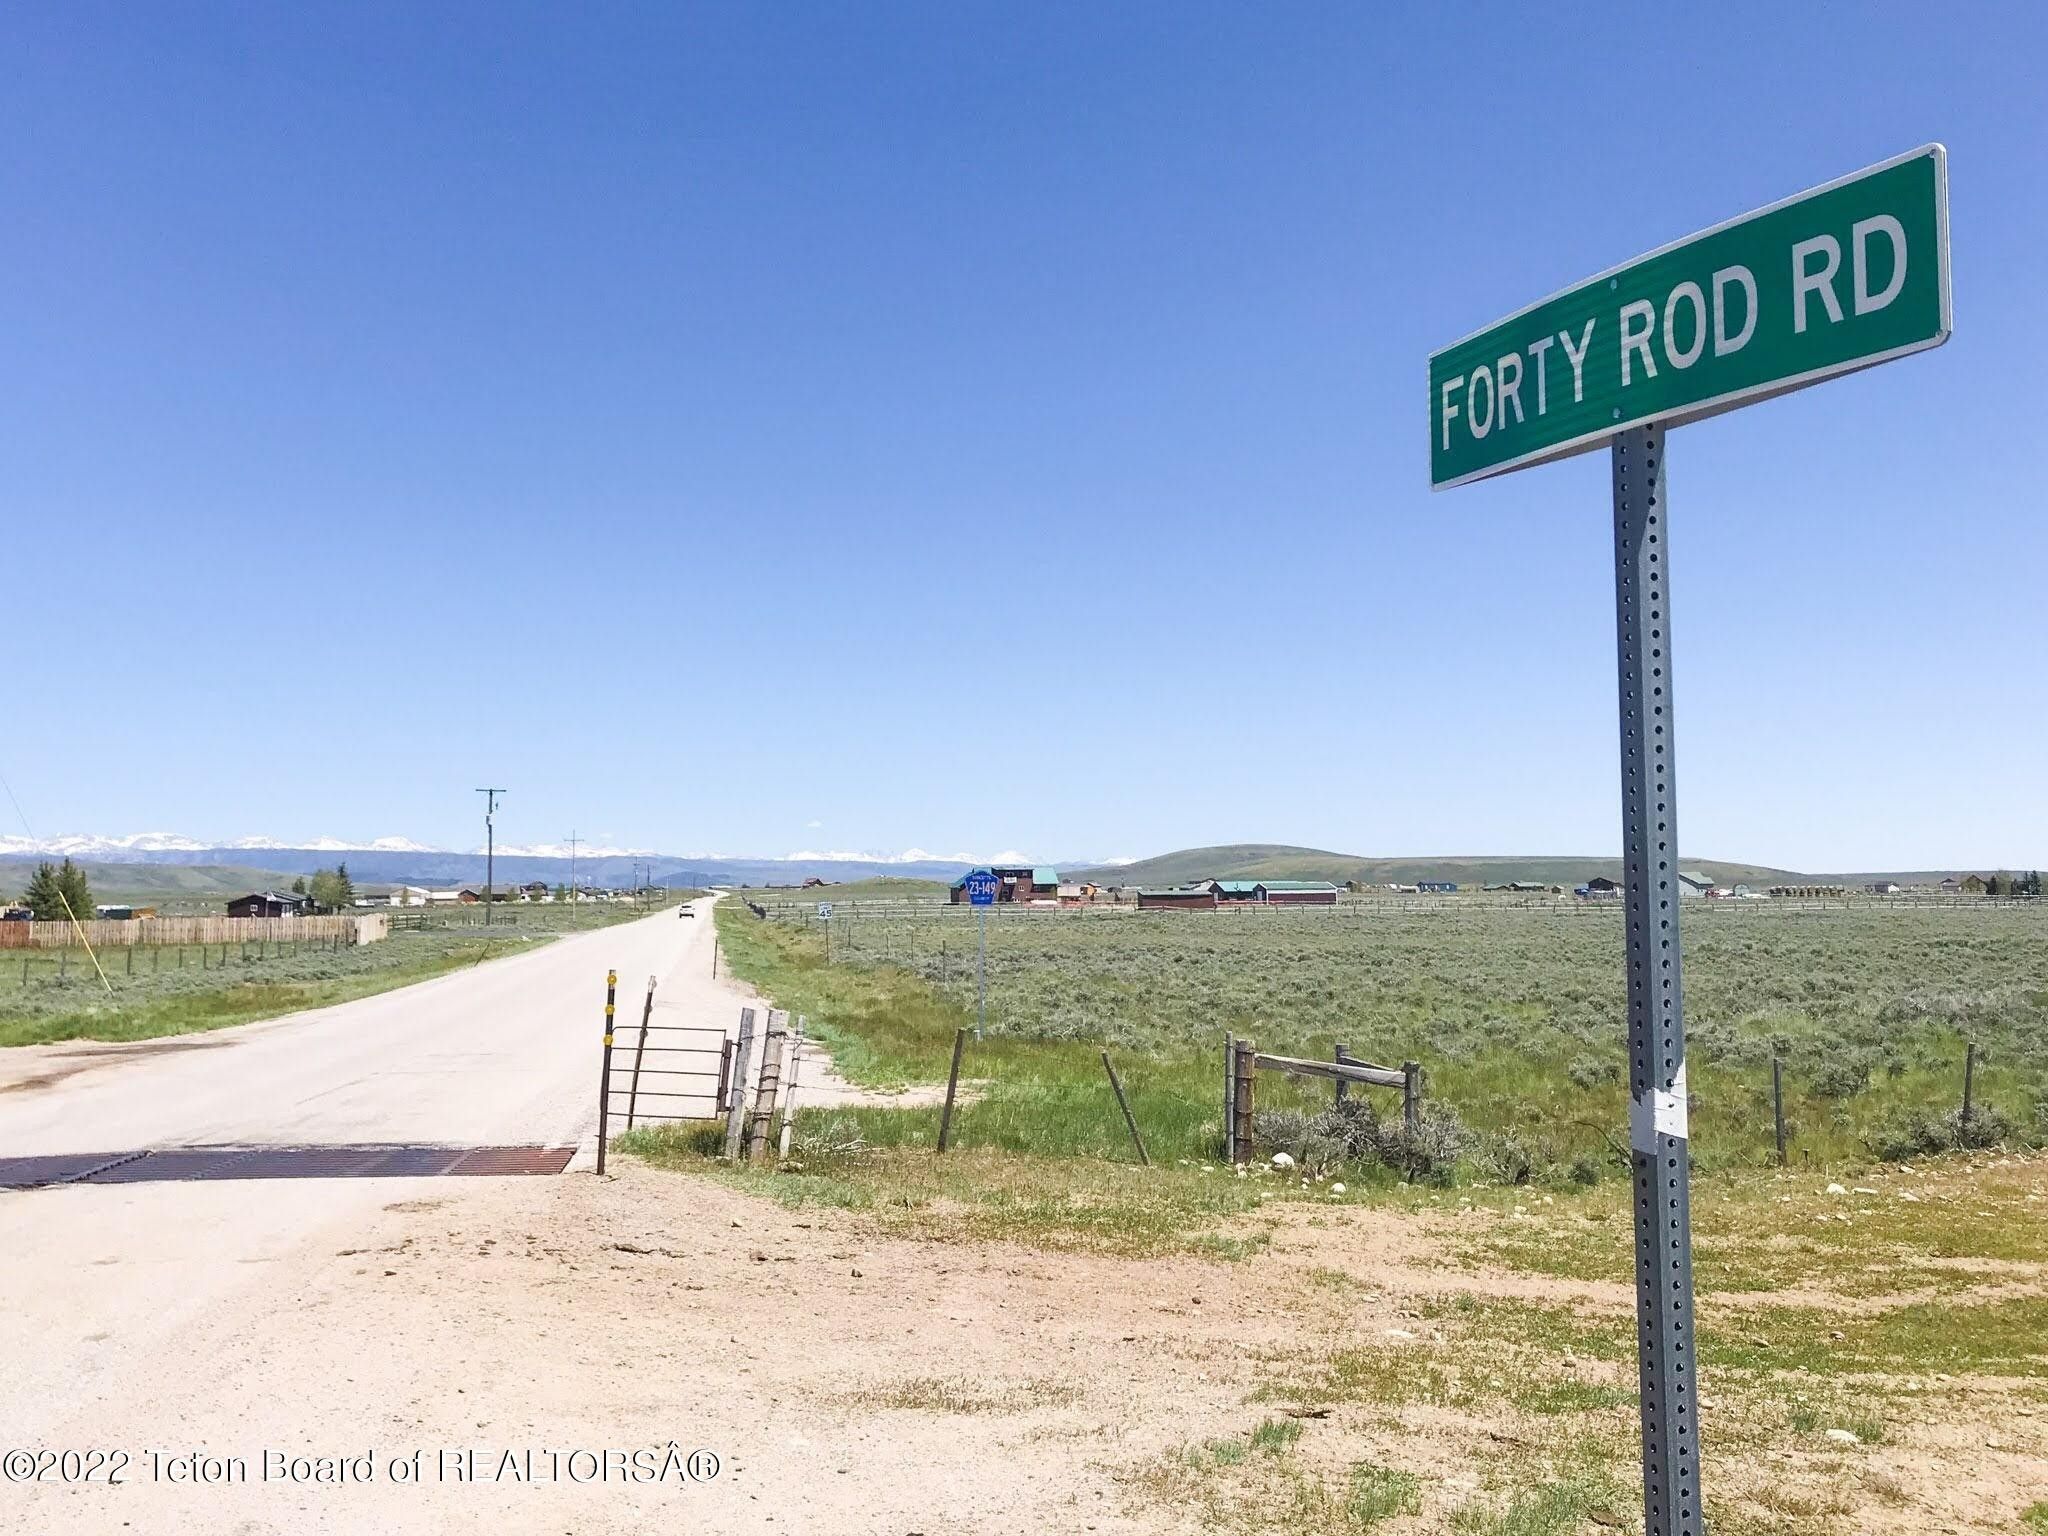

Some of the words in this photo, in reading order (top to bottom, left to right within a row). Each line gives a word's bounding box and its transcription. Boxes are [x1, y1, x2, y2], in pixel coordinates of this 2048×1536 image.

[1441, 317, 1597, 451] FORTY
[1619, 264, 1758, 387] ROD
[1791, 213, 1909, 334] RD
[969, 881, 996, 895] 23-149
[819, 909, 832, 918] 45
